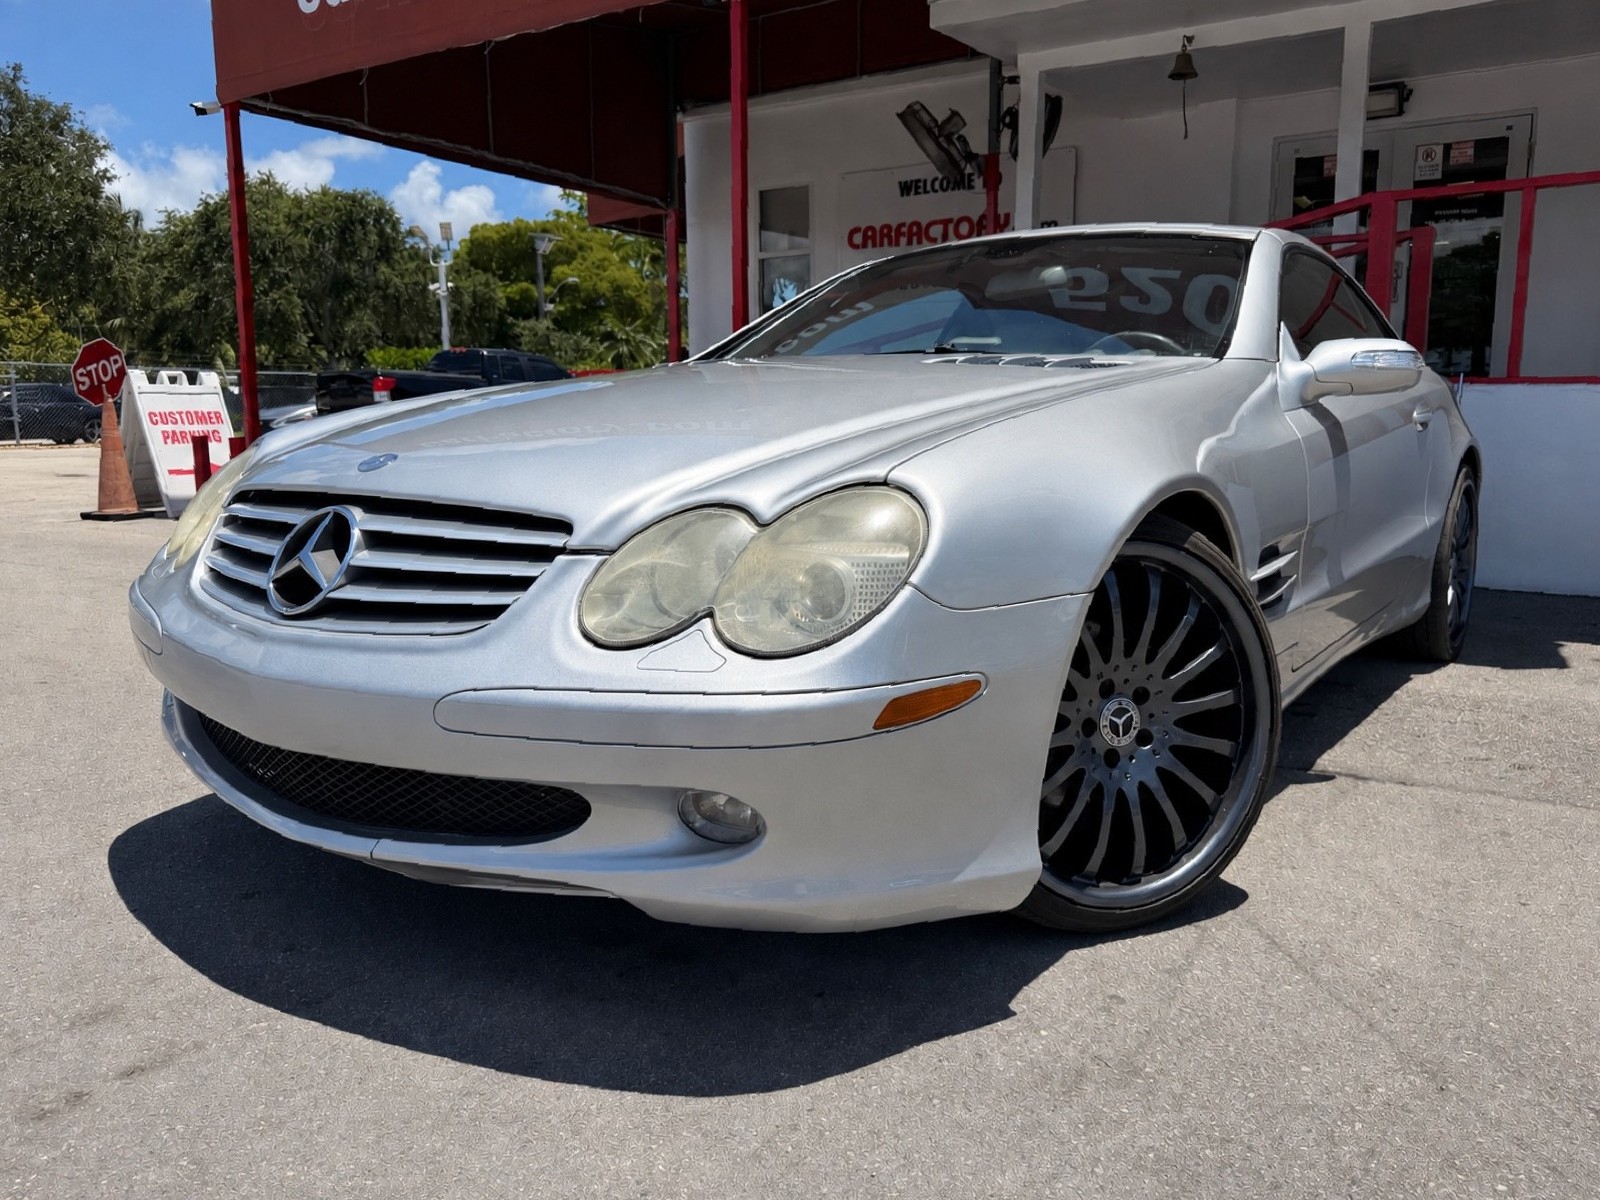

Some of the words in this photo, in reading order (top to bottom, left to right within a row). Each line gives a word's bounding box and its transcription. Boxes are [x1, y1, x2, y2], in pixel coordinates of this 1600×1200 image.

[899, 172, 975, 197] WELCOME
[76, 354, 122, 391] STOP
[147, 410, 224, 426] CUSTOMER
